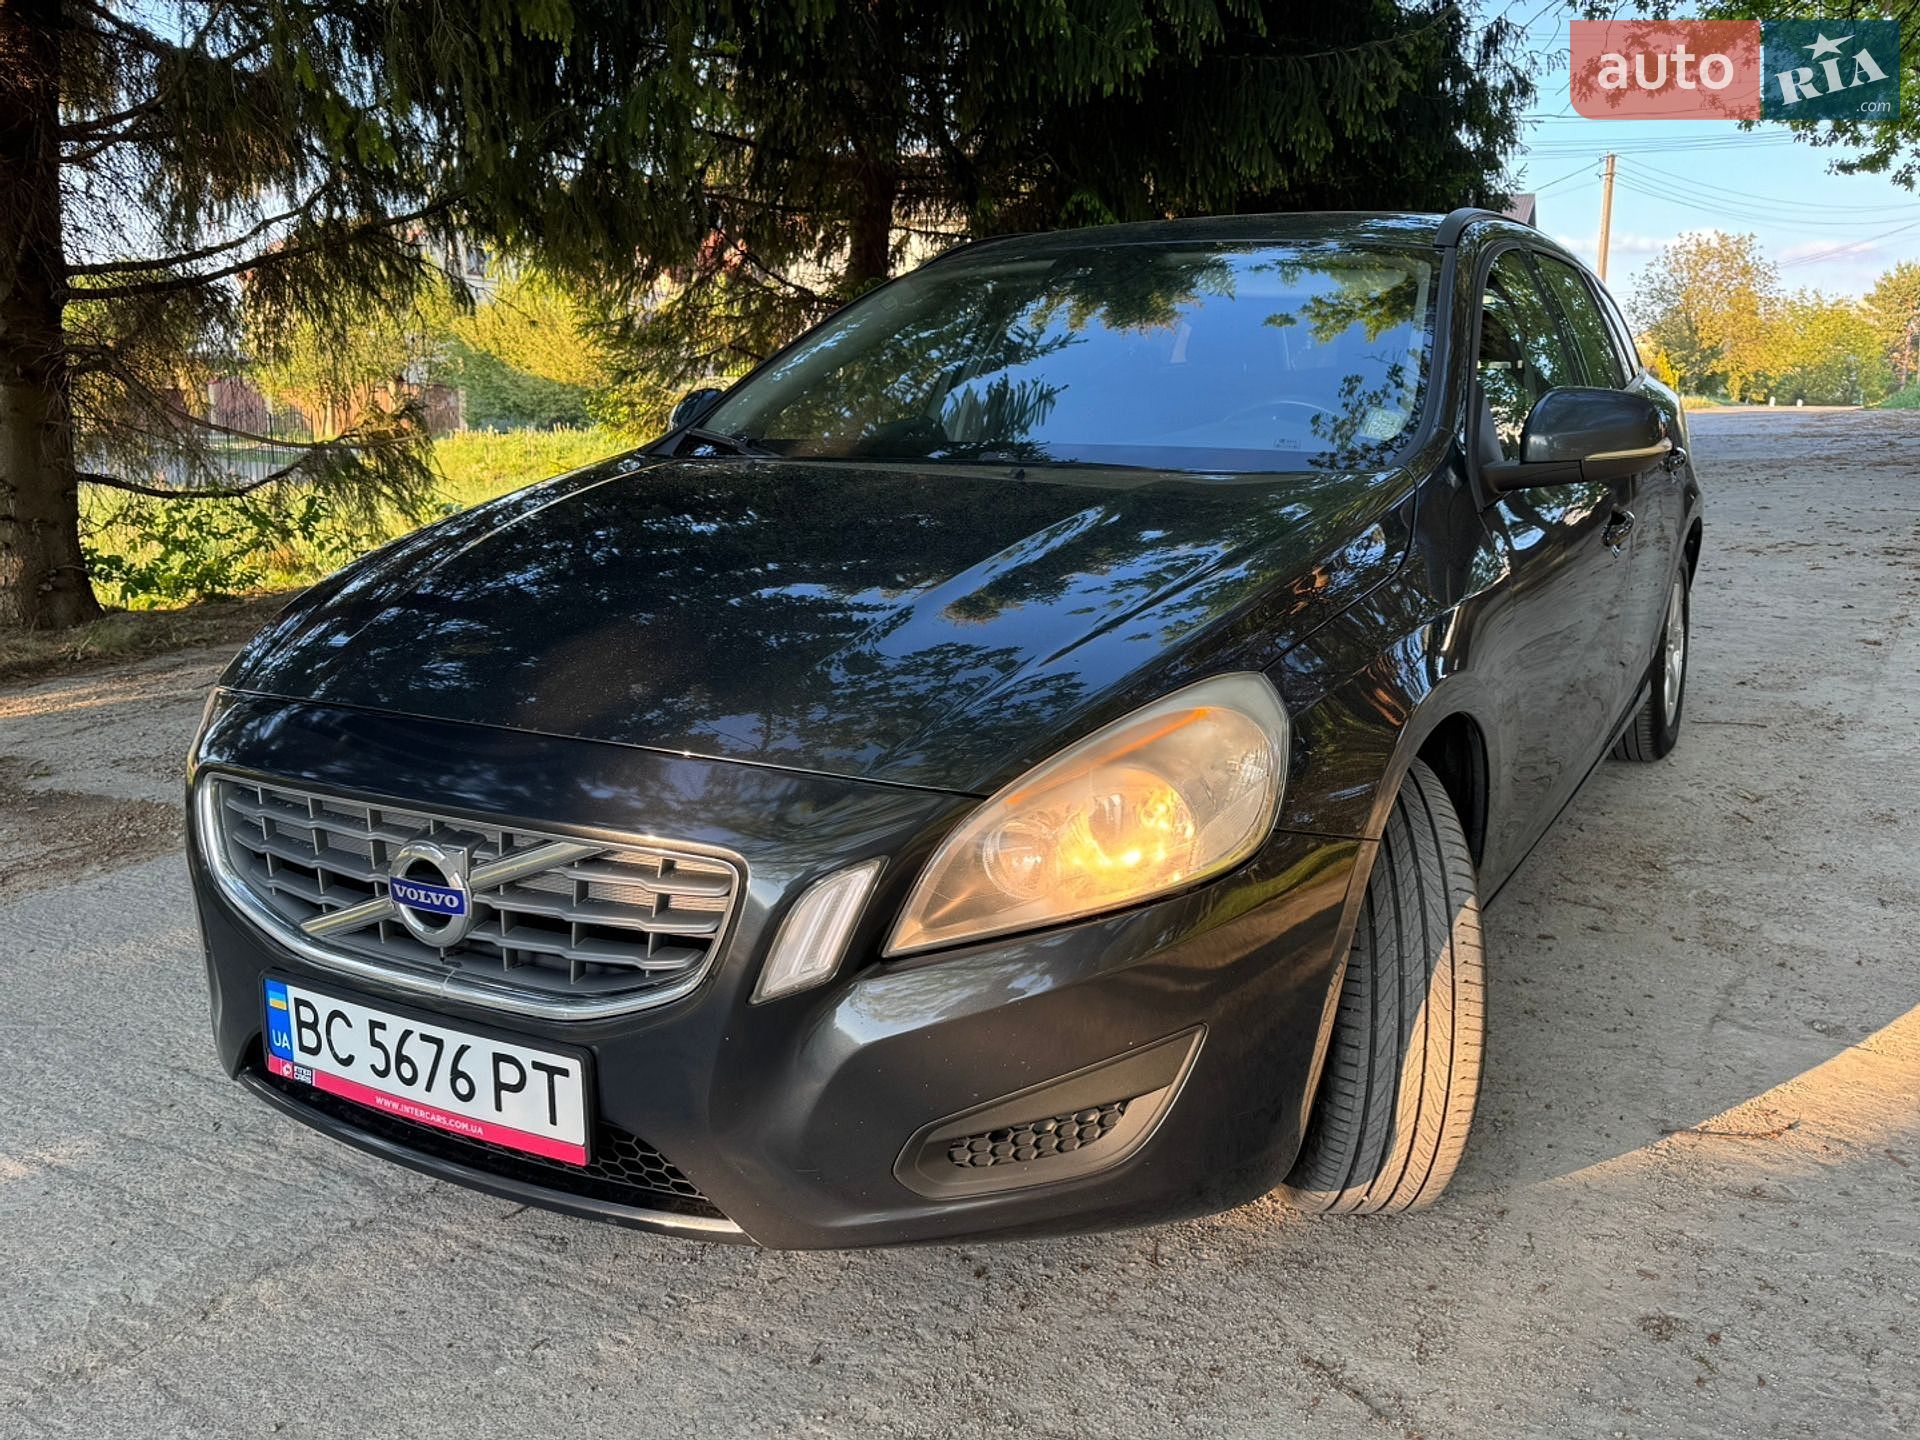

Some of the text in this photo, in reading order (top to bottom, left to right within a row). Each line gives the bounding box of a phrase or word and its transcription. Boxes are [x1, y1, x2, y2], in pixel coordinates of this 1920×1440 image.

[392, 883, 460, 908] VOLVO
[271, 1028, 292, 1050] UA
[293, 996, 571, 1127] BC 5676 PT
[374, 1095, 485, 1136] WWW.INTERCARS.COM.UA
